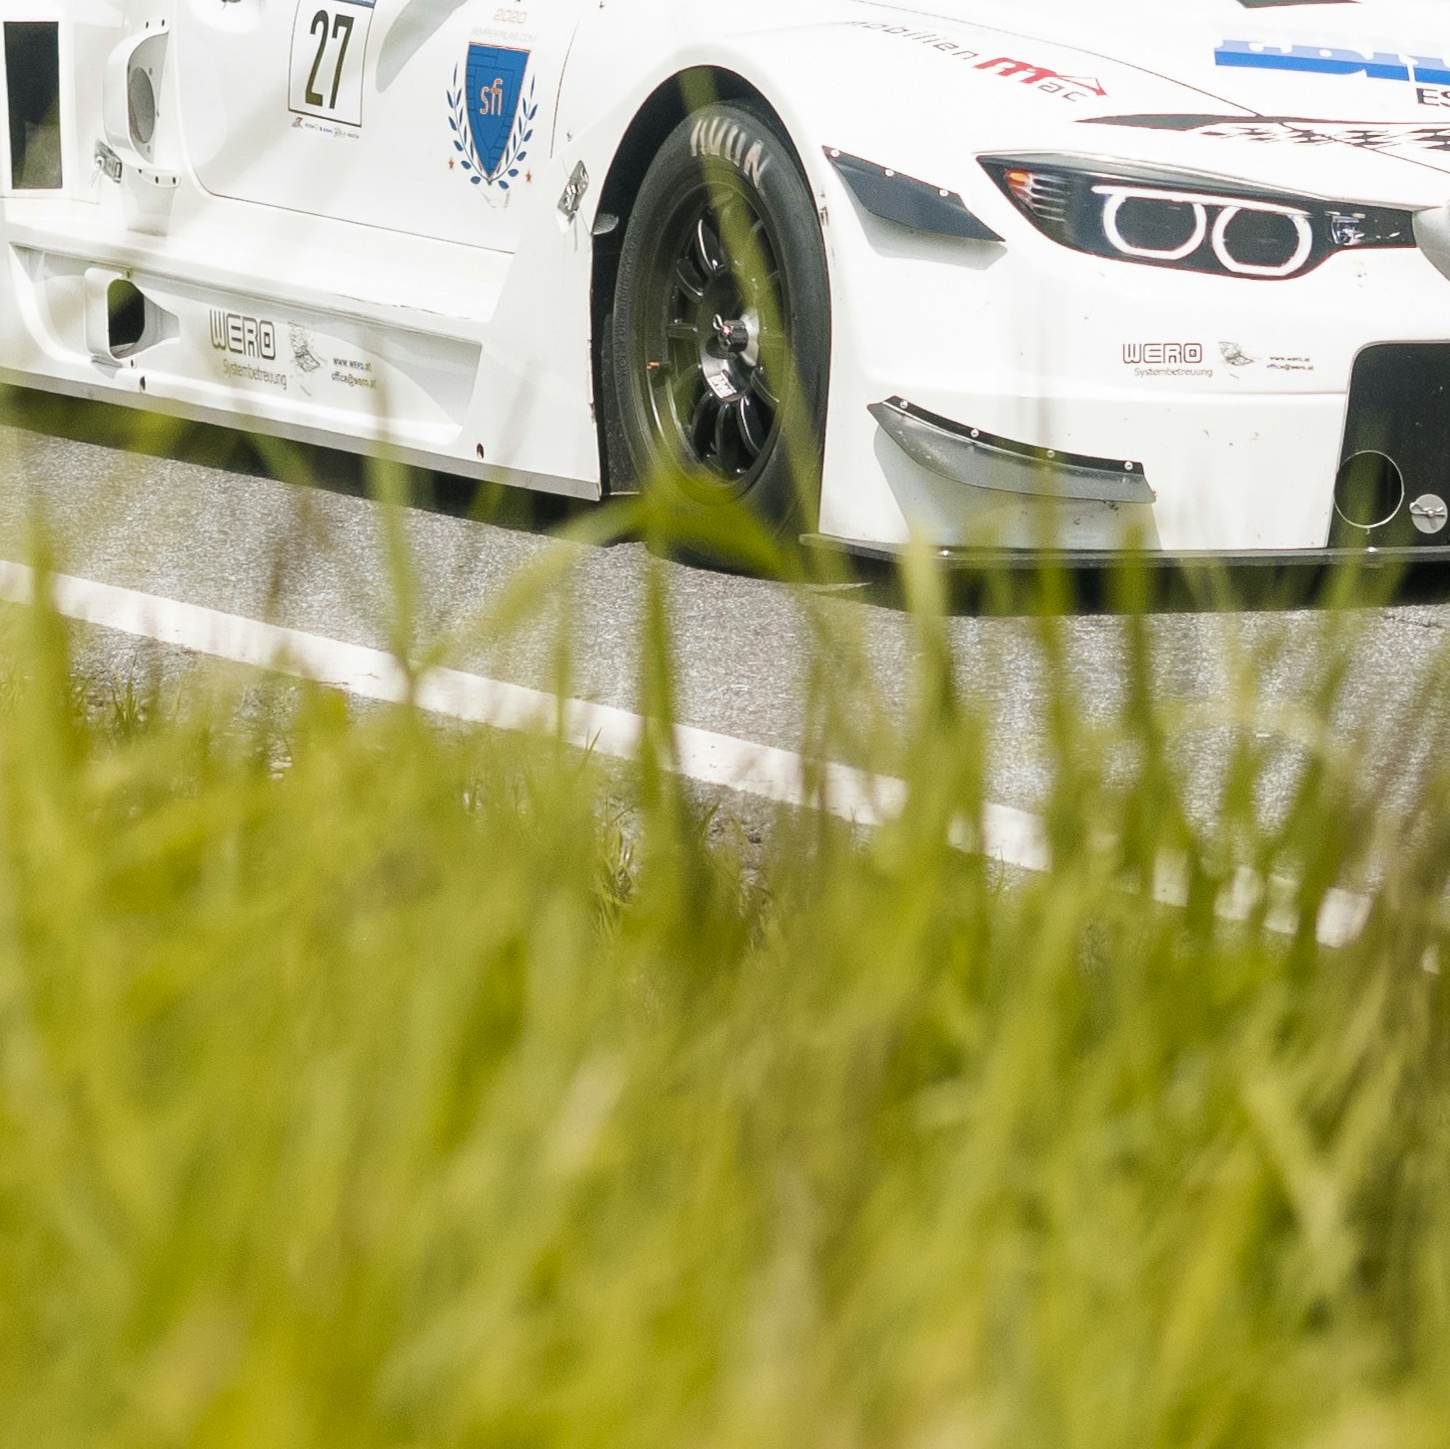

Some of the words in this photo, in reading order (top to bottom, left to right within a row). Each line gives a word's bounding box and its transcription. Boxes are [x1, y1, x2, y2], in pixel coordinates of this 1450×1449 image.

[304, 9, 355, 110] 27
[209, 309, 277, 361] WERO
[1122, 342, 1203, 364] WERO
[222, 358, 288, 391] Systembetreuung
[1134, 366, 1214, 378] Systembetreuung
